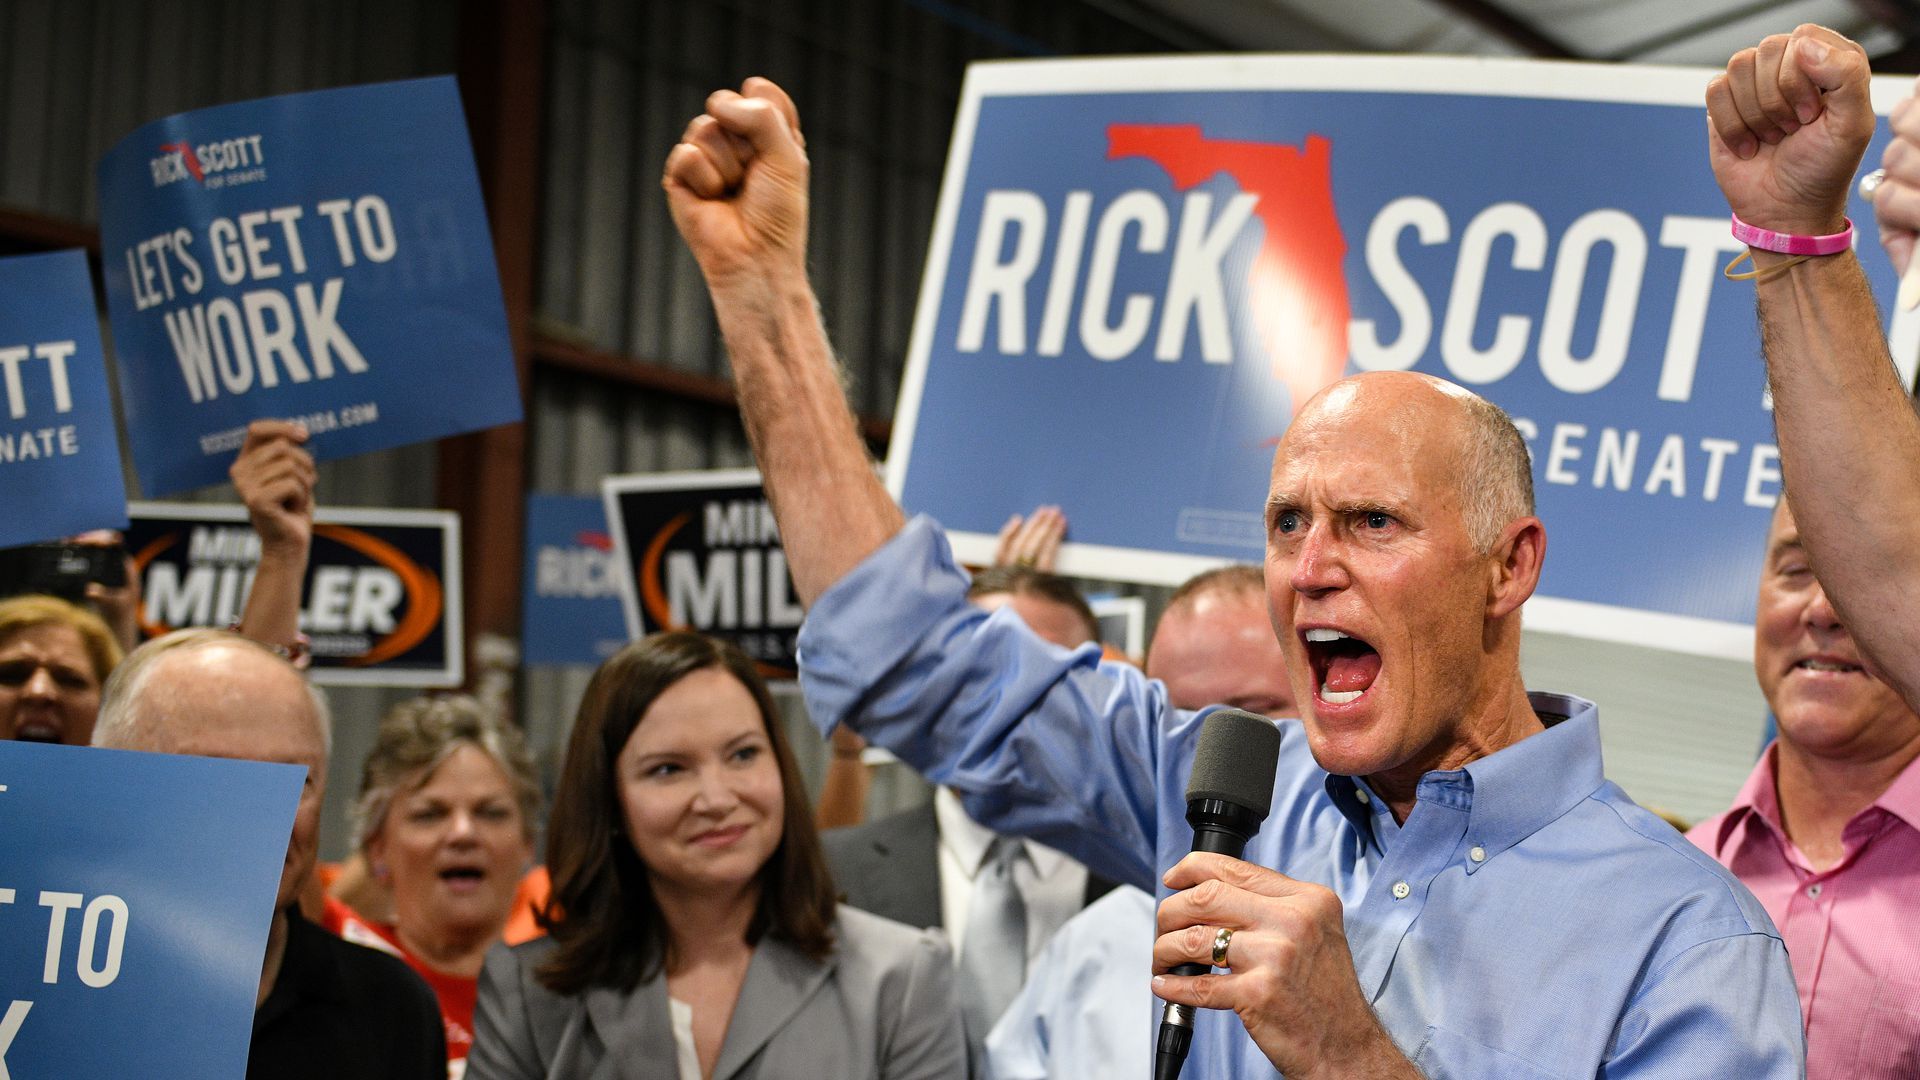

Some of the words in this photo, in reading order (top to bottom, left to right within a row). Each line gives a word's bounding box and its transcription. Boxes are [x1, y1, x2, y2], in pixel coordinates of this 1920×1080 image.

[196, 135, 263, 174] SCOTT
[126, 227, 203, 311] LET'S
[208, 206, 304, 285] GET
[318, 195, 399, 268] TO
[956, 190, 1260, 365] RICK
[1349, 196, 1776, 411] SCOT
[164, 277, 369, 402] WORK
[667, 550, 804, 630] MIL
[38, 890, 129, 988] TO
